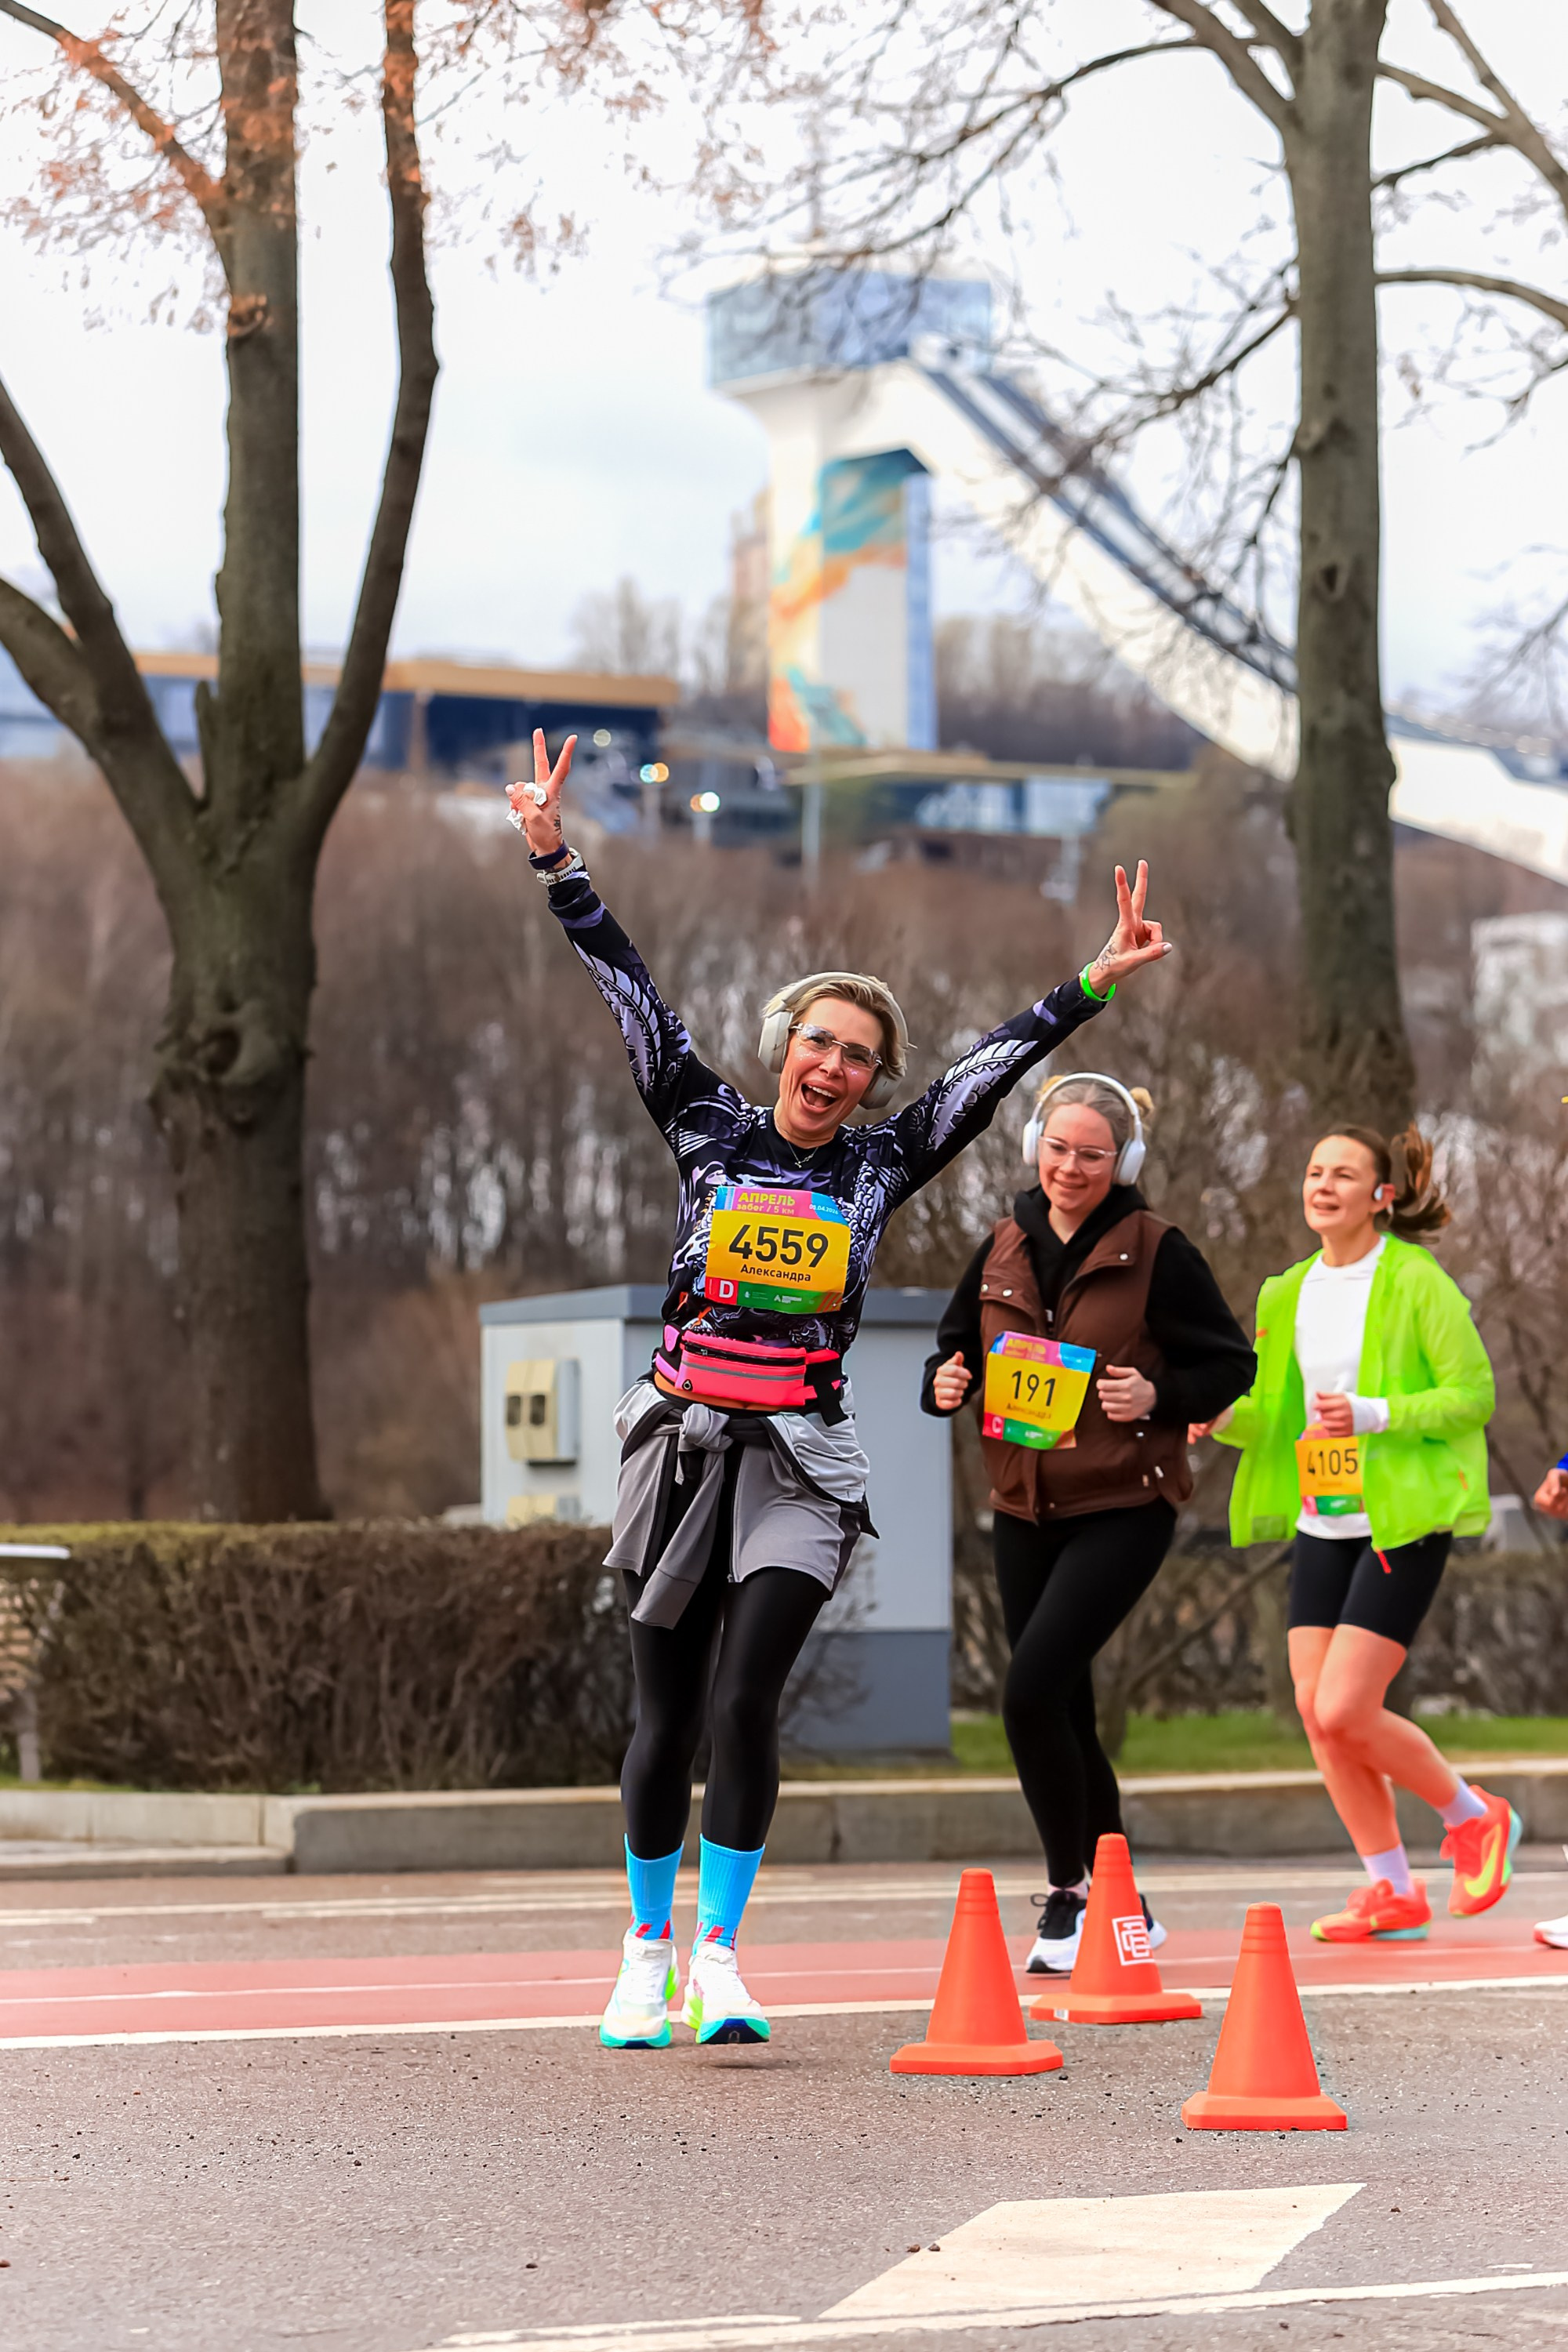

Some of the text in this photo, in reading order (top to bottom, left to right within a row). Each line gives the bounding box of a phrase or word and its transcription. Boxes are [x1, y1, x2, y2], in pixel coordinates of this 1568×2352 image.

[736, 1203, 764, 1212] забег
[739, 1192, 795, 1206] АПРЕЛЬ
[729, 1225, 829, 1268] 4559
[740, 1264, 811, 1282] Александра
[719, 1280, 734, 1298] D
[1011, 1370, 1056, 1406] 191
[1307, 1448, 1359, 1475] 4105
